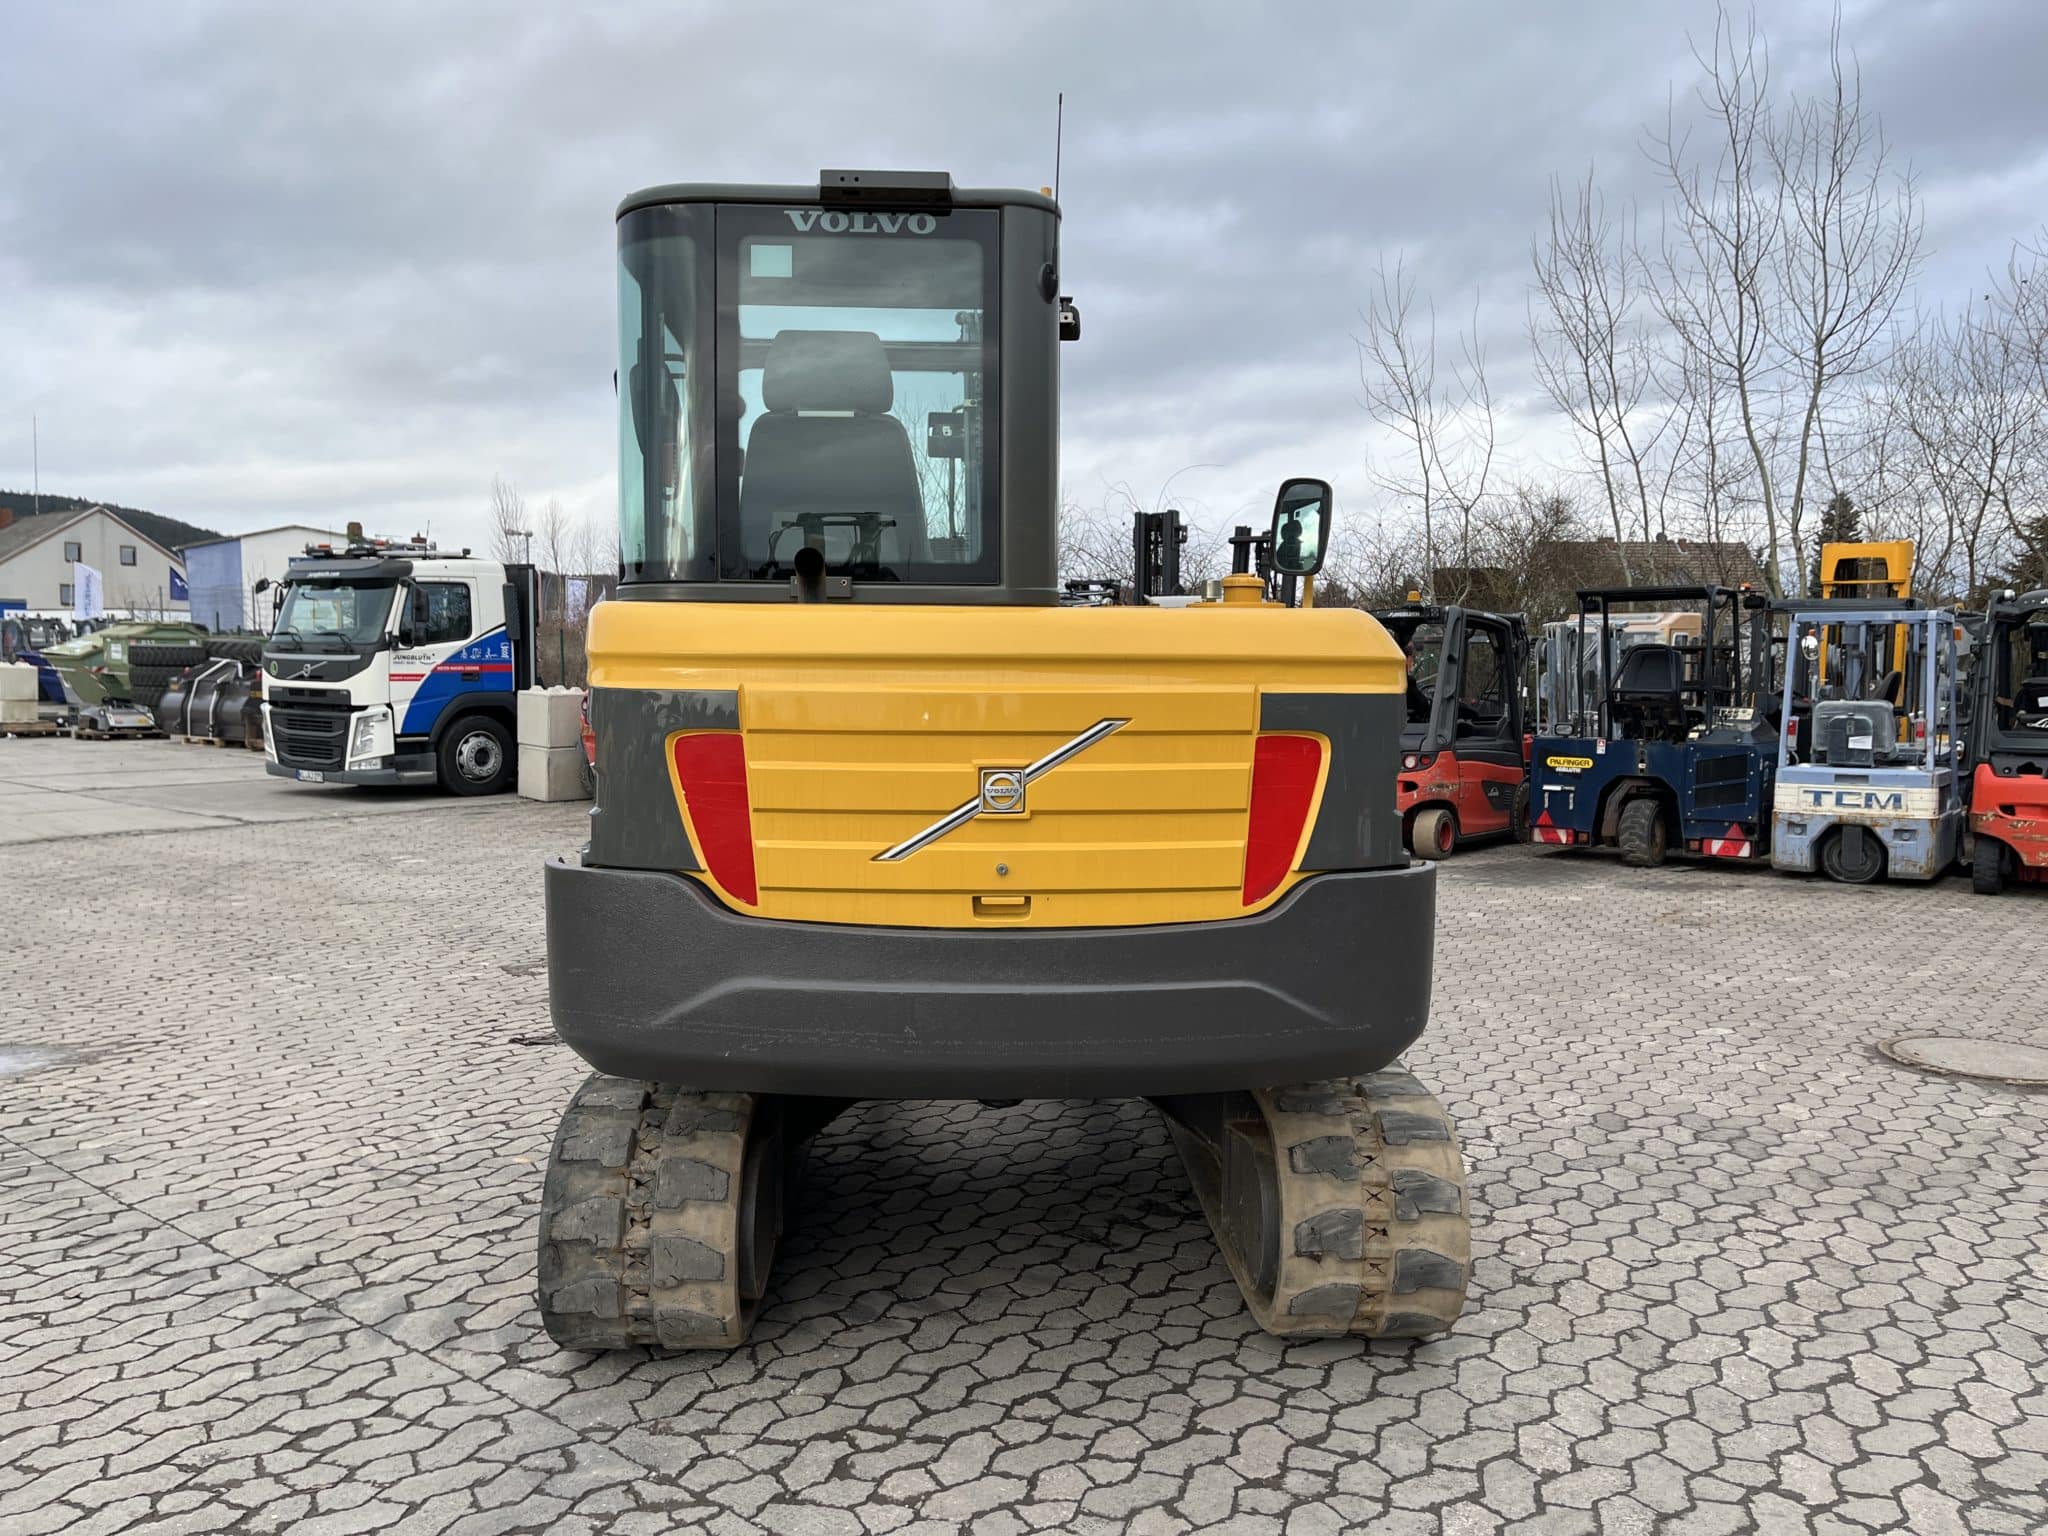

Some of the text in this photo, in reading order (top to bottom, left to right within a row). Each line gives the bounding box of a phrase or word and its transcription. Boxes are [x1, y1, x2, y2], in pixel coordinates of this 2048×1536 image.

[784, 210, 936, 234] VOLVO
[1549, 758, 1590, 767] PALFINGER
[1803, 790, 1902, 809] TCM
